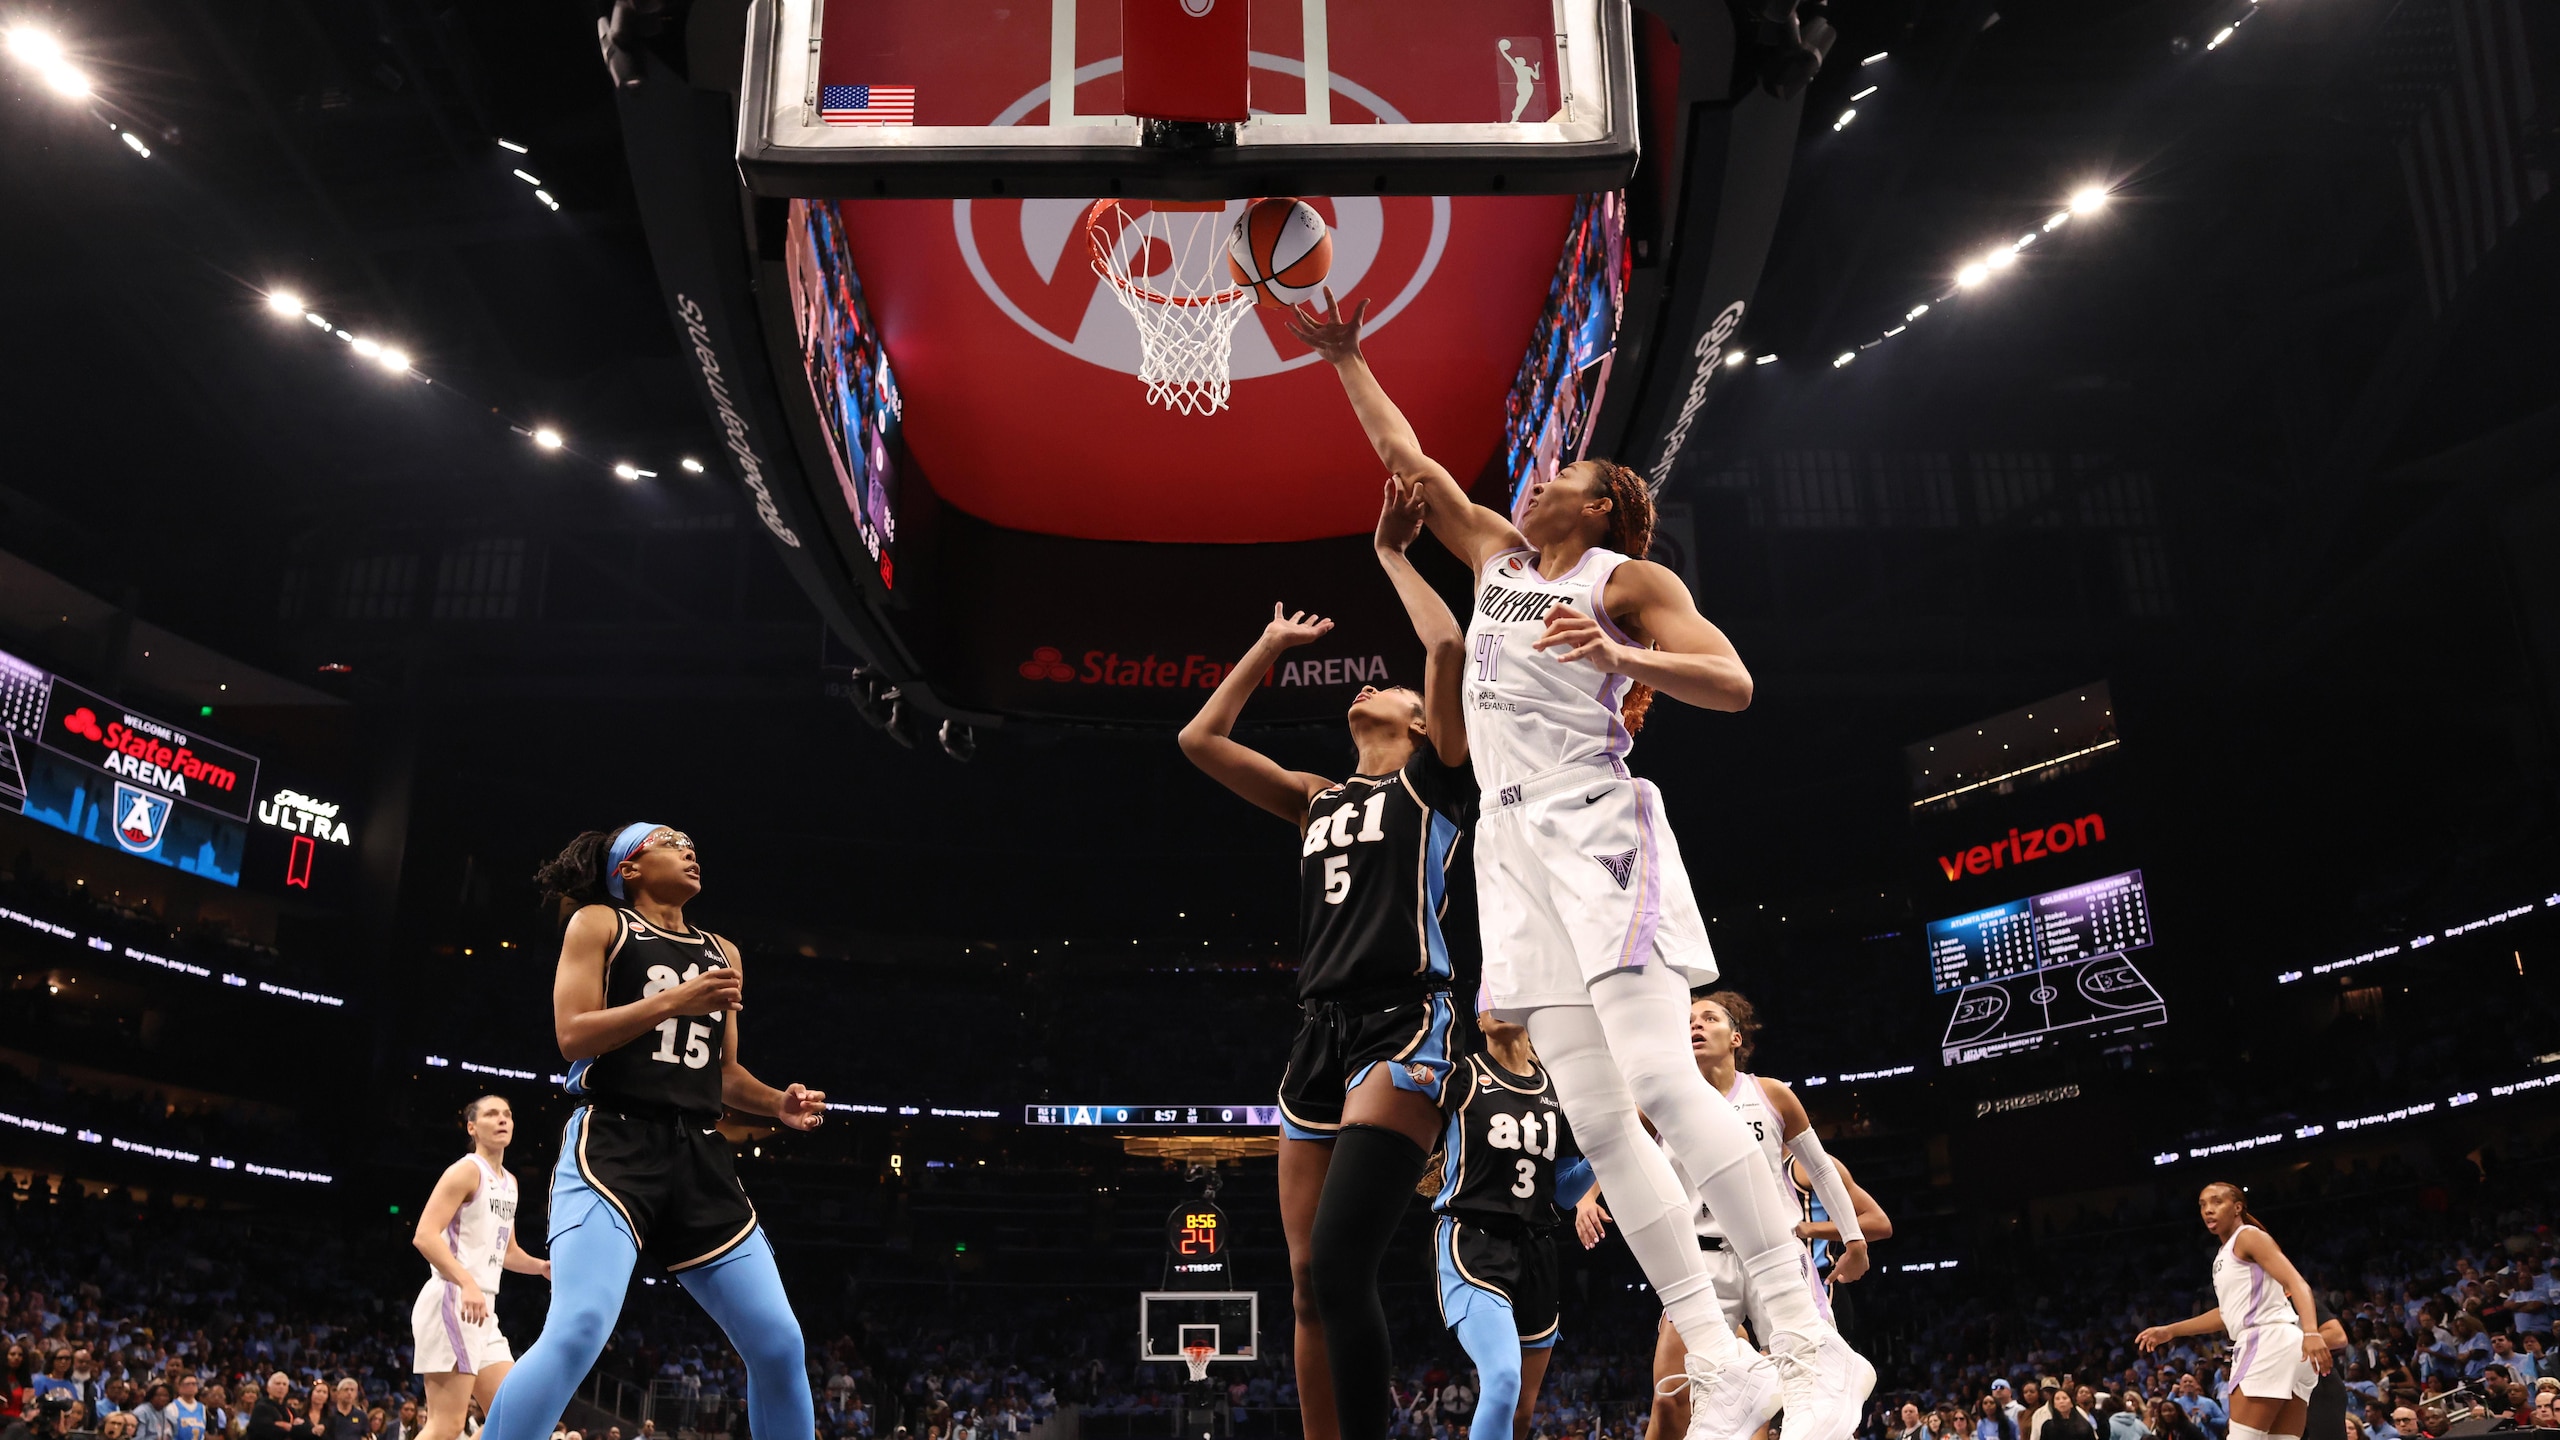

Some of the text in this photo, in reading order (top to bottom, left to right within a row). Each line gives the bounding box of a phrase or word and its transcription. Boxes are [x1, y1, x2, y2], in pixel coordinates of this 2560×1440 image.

[1475, 634, 1505, 682] 41
[1280, 655, 1389, 688] ARENA
[123, 713, 187, 747] WELCOME TO
[103, 750, 187, 797] ARENA
[1500, 784, 1522, 806] GSV
[258, 800, 351, 846] ULTRA
[1302, 792, 1386, 858] atl
[1938, 812, 2107, 882] verizon
[1323, 853, 1351, 905] 5
[2545, 893, 2560, 907] zi
[1951, 908, 2006, 929] ATLANTA DREAM
[651, 1017, 712, 1070] 15
[550, 1073, 567, 1084] zi
[2545, 1074, 2560, 1085] pa
[1037, 1115, 1056, 1123] TOL 5
[1038, 1108, 1049, 1116] FLS
[1117, 1110, 1128, 1122] 0
[1154, 1110, 1177, 1122] 8:57
[1187, 1115, 1198, 1123] 1ST
[1222, 1109, 1233, 1122] 0
[1487, 1111, 1557, 1161] atl
[1511, 1158, 1537, 1199] 3
[1186, 1213, 1217, 1229] 8:56
[1181, 1229, 1215, 1254] 24
[1187, 1264, 1223, 1272] TISSOT
